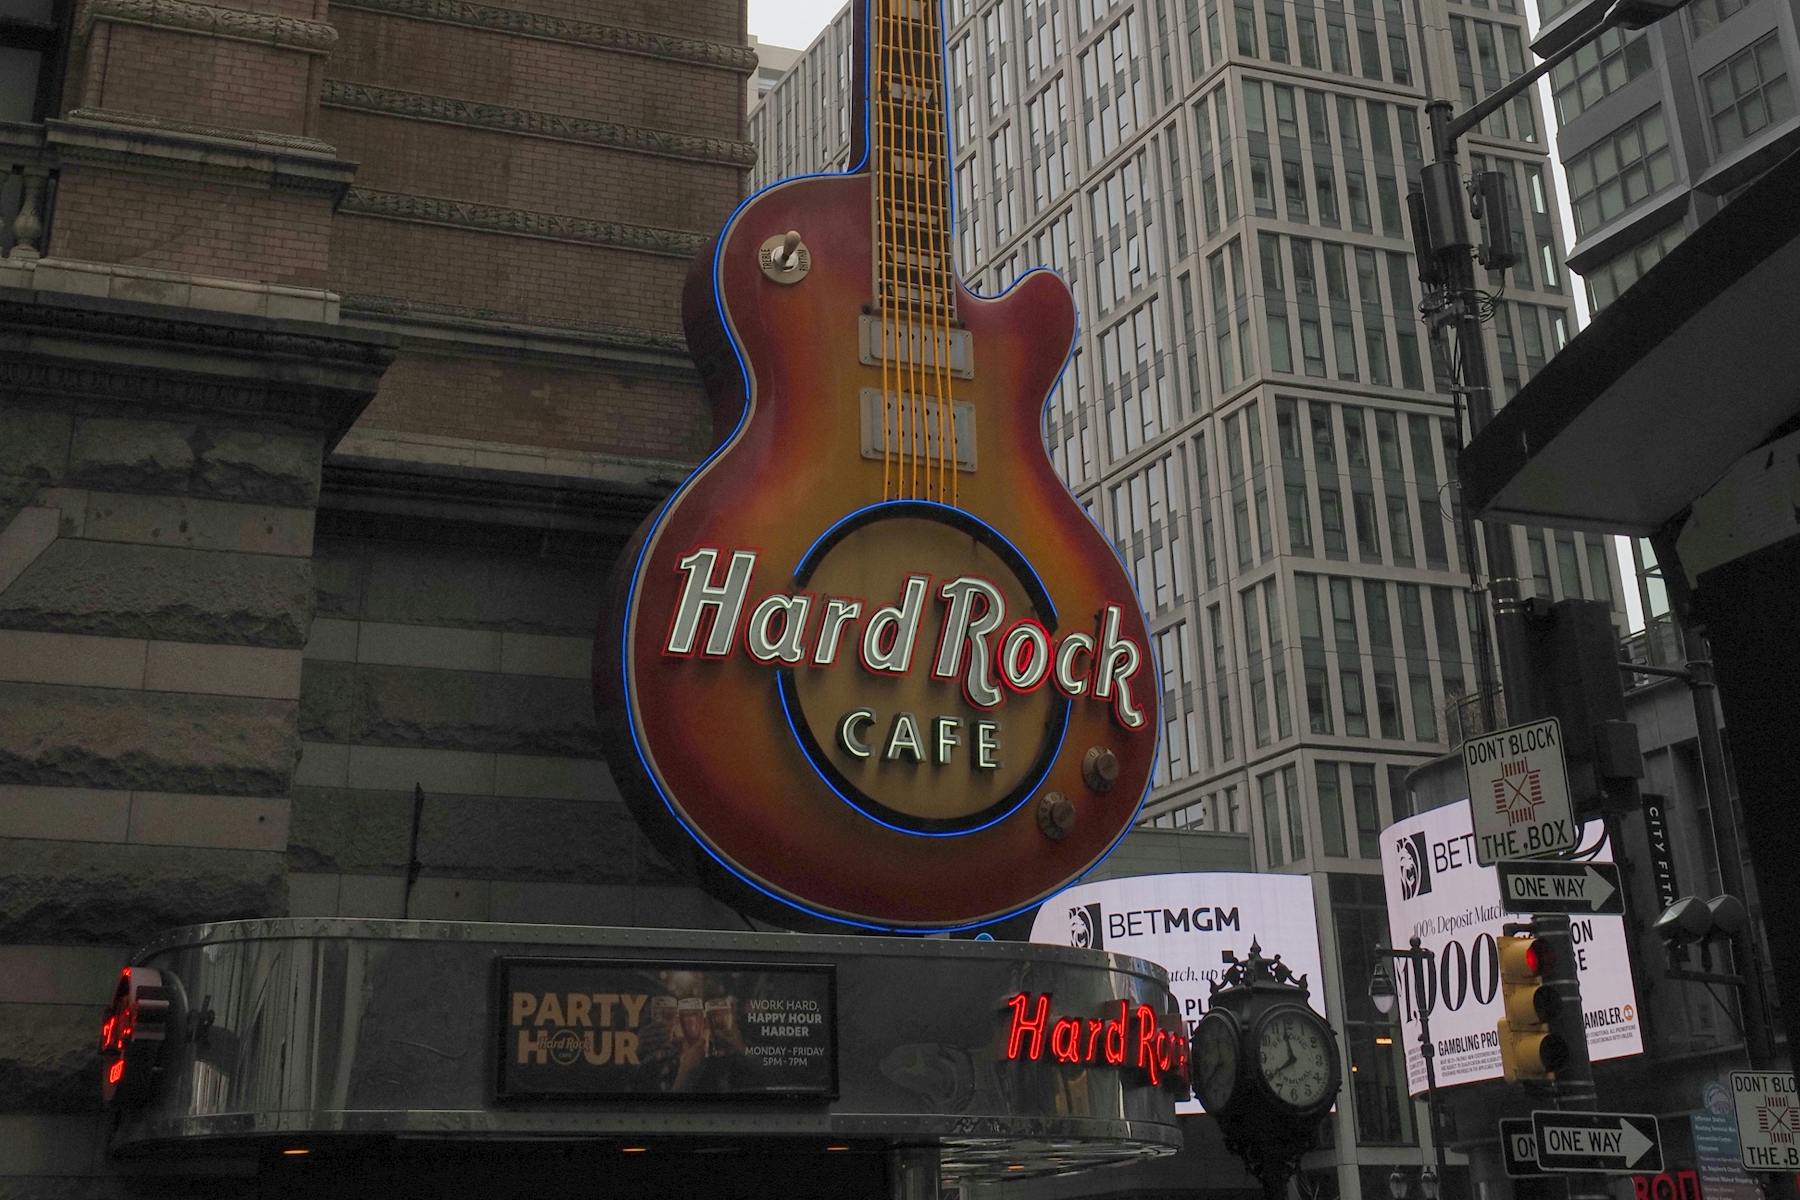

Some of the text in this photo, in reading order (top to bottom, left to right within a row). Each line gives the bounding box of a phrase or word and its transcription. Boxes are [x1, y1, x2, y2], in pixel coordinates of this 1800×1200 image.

[666, 548, 1148, 731] Hard Rock
[840, 707, 1004, 769] CAFE
[1509, 725, 1556, 755] BLOCK
[1482, 820, 1568, 859] THE BOX
[1433, 833, 1474, 873] BET
[1649, 806, 1674, 907] CITY FITN
[1514, 877, 1585, 897] ONE WAY
[1109, 906, 1240, 939] BETMGM
[1437, 909, 1473, 936] Deposit
[511, 991, 649, 1028] PARTY
[747, 1013, 822, 1024] HAPPY HOUR
[750, 1000, 820, 1012] WORK HARD,
[1584, 1007, 1625, 1029] AMBLER.
[761, 1026, 809, 1037] HARDER
[1008, 992, 1128, 1065] Hard
[745, 1046, 786, 1056] MONDAY
[792, 1047, 824, 1056] FRIDAY
[1438, 1034, 1480, 1057] GAMBLING
[1517, 1137, 1536, 1158] ON
[1549, 1130, 1622, 1153] ONE WAY
[1746, 1145, 1780, 1165] THE
